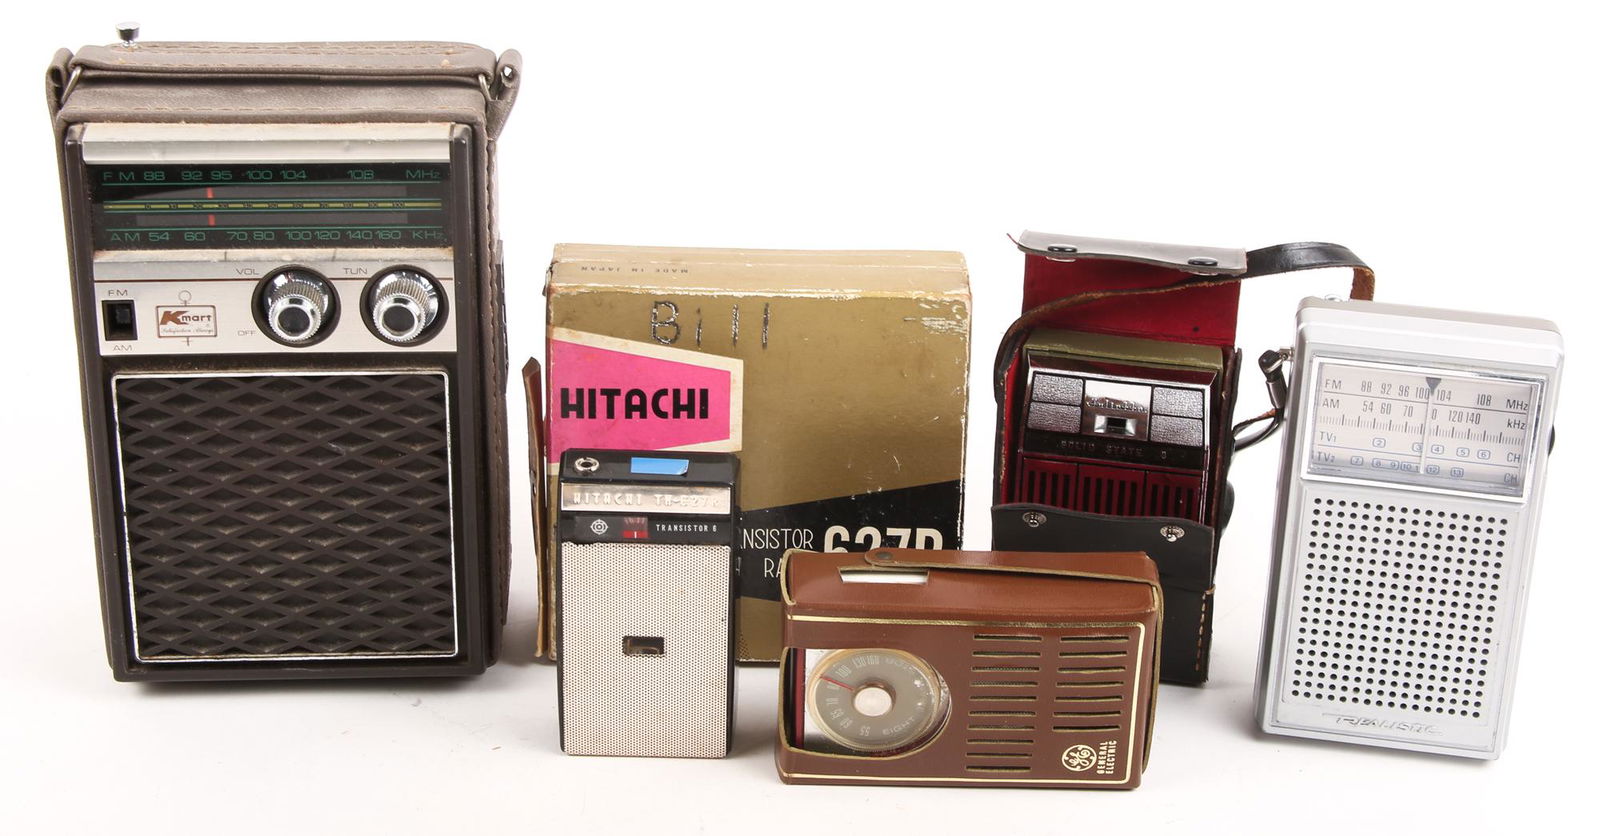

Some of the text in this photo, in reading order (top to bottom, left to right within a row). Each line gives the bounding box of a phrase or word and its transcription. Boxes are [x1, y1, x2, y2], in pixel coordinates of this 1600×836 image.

[143, 171, 165, 181] 88
[181, 171, 203, 180] 92
[211, 170, 233, 180] 95
[246, 170, 272, 180] 100
[280, 170, 307, 179] 104
[347, 170, 374, 179] 108
[149, 231, 169, 241] 54
[184, 231, 206, 241] 60
[226, 231, 248, 241] 70
[253, 231, 275, 241] 80
[286, 231, 312, 240] 100
[314, 230, 340, 240] 120
[346, 230, 373, 240] 140
[375, 230, 401, 240] 160
[343, 267, 368, 275] TUN
[560, 387, 709, 419] HITACHI
[1324, 379, 1529, 411] FM 88 92 96 100 104 108 MHz
[1322, 398, 1340, 409] AM
[1362, 400, 1374, 413] 54
[1380, 402, 1392, 415] 60
[1403, 405, 1414, 417] 70
[1448, 410, 1463, 423] 120
[1465, 412, 1481, 425] 140
[1506, 418, 1526, 430] kHz
[1507, 452, 1521, 463] CH
[573, 492, 642, 505] HITACHI
[656, 524, 717, 532] TRANSISTOR 6
[741, 528, 814, 550] NSISTOR
[1096, 741, 1108, 775] GENERAL
[1105, 740, 1117, 775] ELECTRIC
